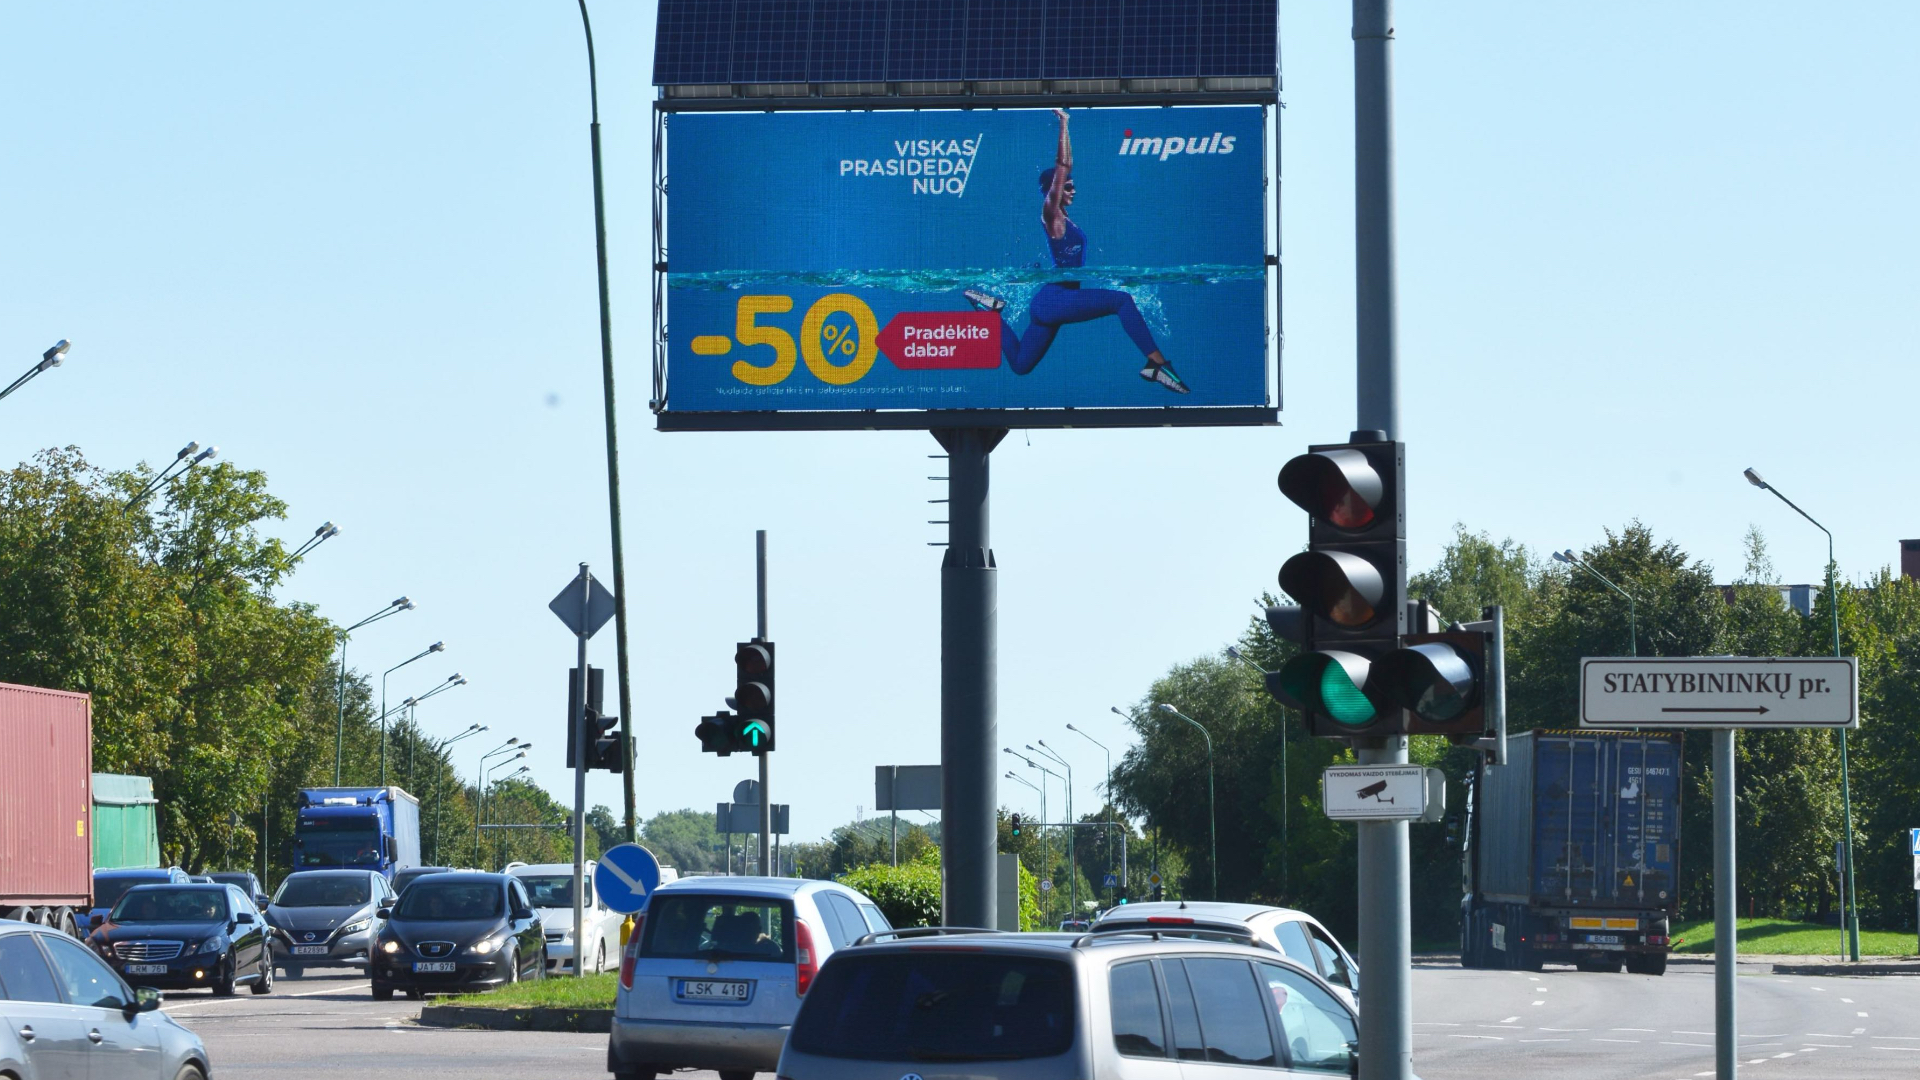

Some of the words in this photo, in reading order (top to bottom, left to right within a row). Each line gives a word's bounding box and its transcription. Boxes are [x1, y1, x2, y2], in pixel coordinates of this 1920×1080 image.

[894, 139, 976, 157] VISKAS
[1119, 128, 1237, 161] impuls
[840, 158, 969, 176] PRASIDEDA
[913, 177, 963, 194] NUO
[904, 324, 990, 341] Pradėkite
[904, 342, 957, 358] dabar
[1603, 672, 1792, 699] STATYBININKŲ
[1798, 677, 1831, 699] pr.
[1385, 769, 1419, 777] STEBĖJIMAS
[130, 965, 147, 973] LRM
[151, 965, 166, 973] 761
[417, 962, 434, 972] JAT
[438, 962, 455, 971] 976
[685, 983, 714, 996] LSK
[721, 984, 746, 997] 418
